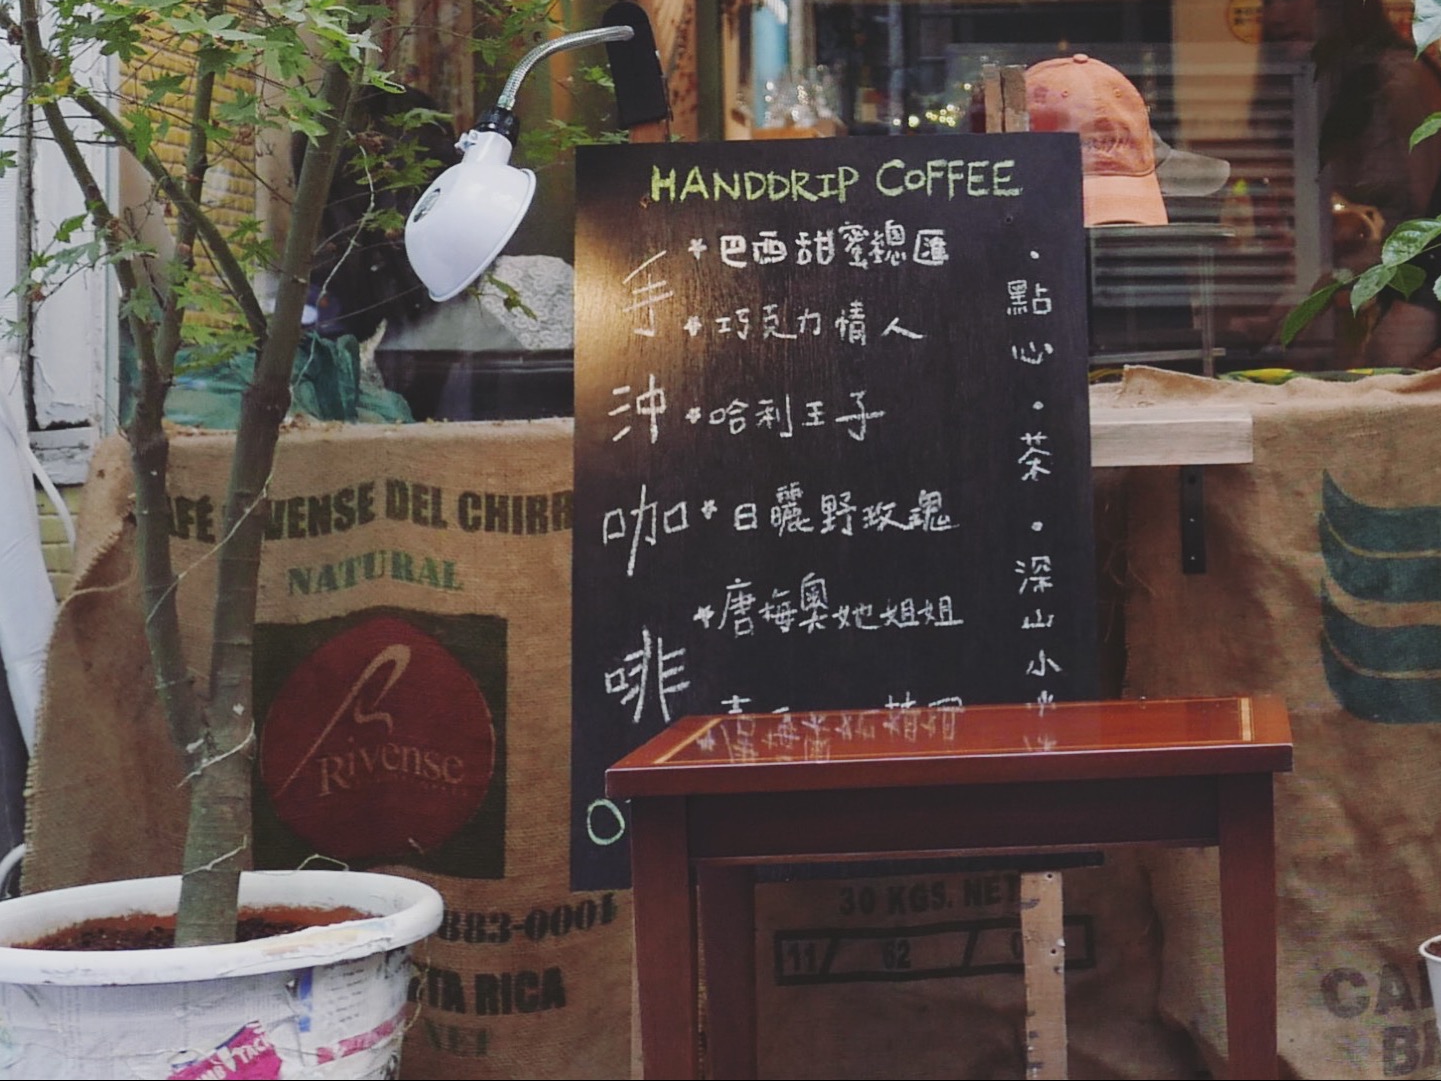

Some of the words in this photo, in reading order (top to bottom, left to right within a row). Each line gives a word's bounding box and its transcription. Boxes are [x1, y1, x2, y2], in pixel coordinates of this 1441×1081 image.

[650, 164, 860, 203] HANDDRIP
[720, 219, 949, 270] 巴西甜蜜總匯
[715, 300, 926, 346] 巧克力情人
[1007, 279, 1054, 364] 點心
[708, 390, 886, 441] 哈利王子
[1017, 431, 1053, 482] 茶
[385, 478, 449, 530] DEL
[734, 482, 959, 537] 日曬野玫瑰
[287, 550, 464, 596] NATURAL
[318, 736, 464, 797] Rivense
[474, 965, 567, 1016] RICA
